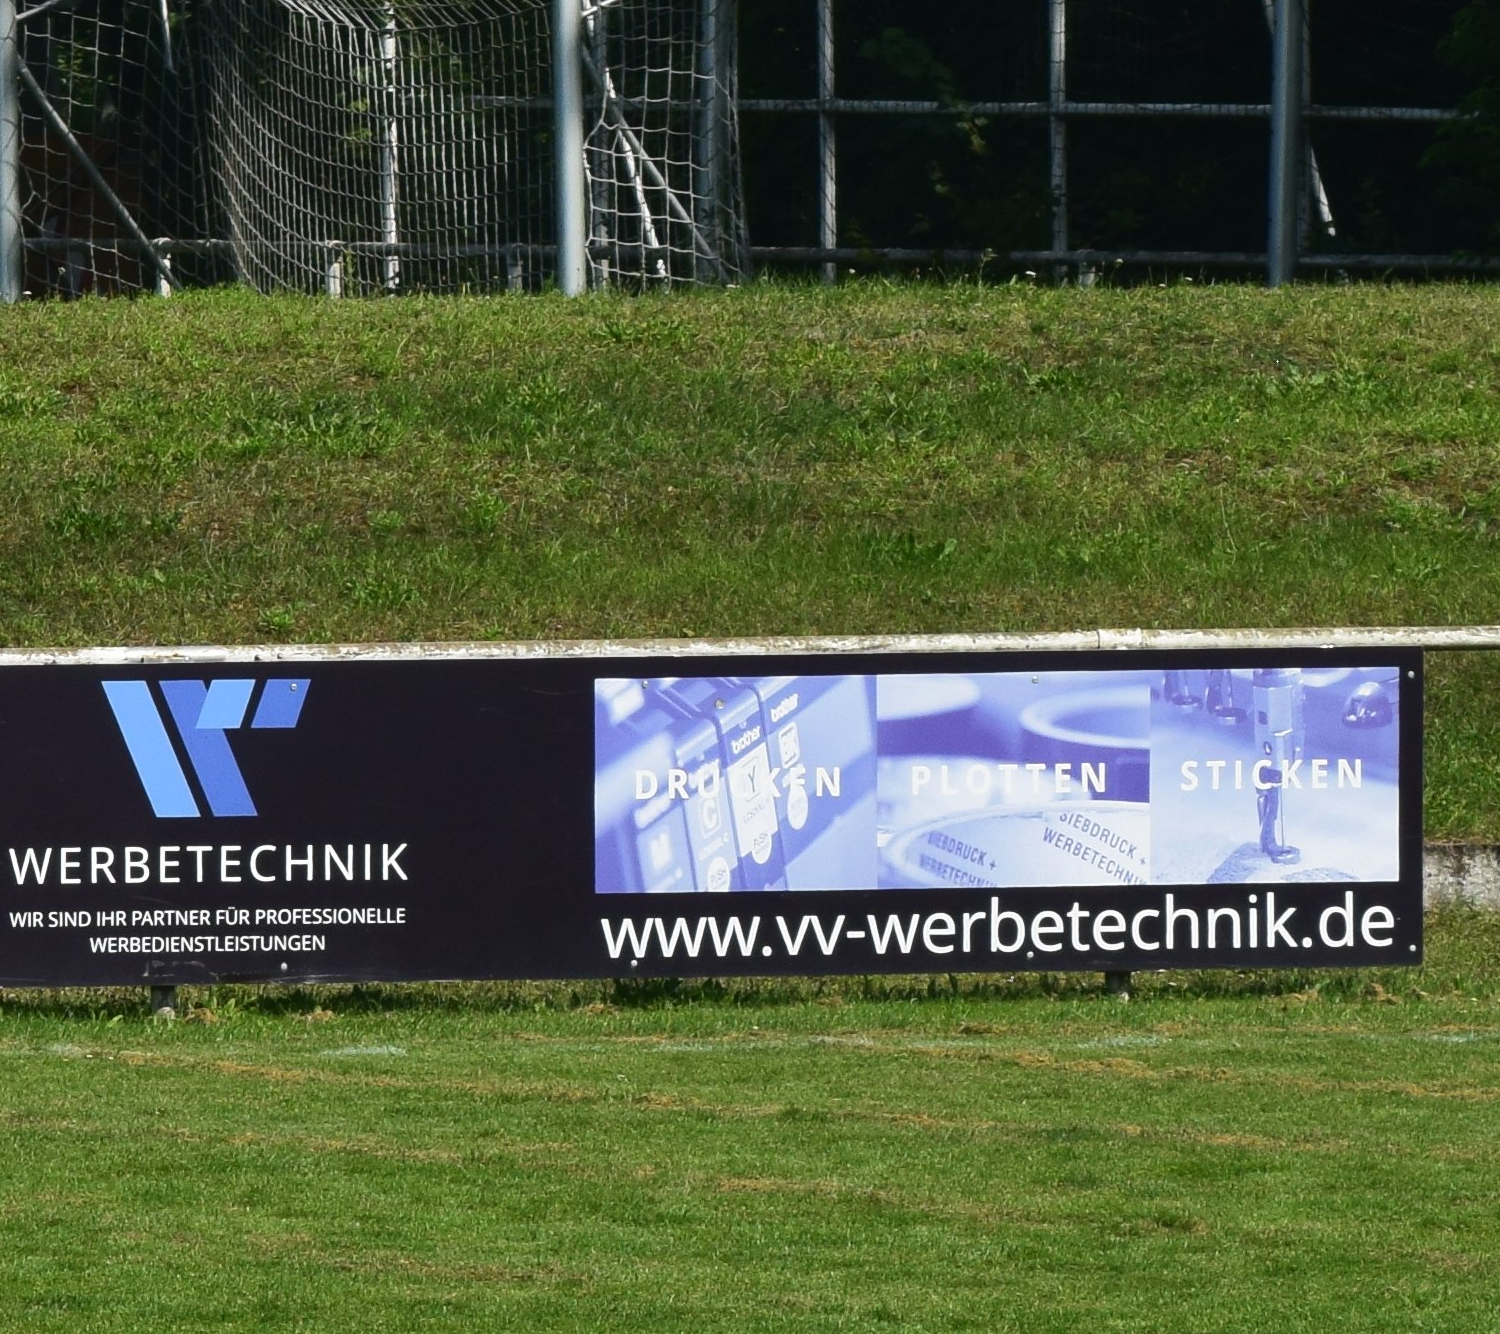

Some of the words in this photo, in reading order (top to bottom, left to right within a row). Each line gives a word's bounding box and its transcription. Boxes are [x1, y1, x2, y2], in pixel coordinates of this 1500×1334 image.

[635, 766, 841, 800] DRUKEN
[911, 762, 1107, 796] PLOTTEN
[1180, 758, 1362, 791] STICKEN
[1059, 811, 1138, 859] SIEBDRUCK
[8, 842, 409, 885] WERBETECHNIK
[9, 911, 44, 928] WIR
[48, 911, 92, 928] SIND
[96, 910, 128, 927] IHR
[131, 909, 211, 927] PARTNER
[215, 906, 250, 926] FÜR
[255, 907, 407, 925] PROFESSIONELLE
[600, 890, 1395, 959] www.vv-werbetechnik.de
[89, 934, 326, 954] WERBEDIENSTLEISTUNGEN
